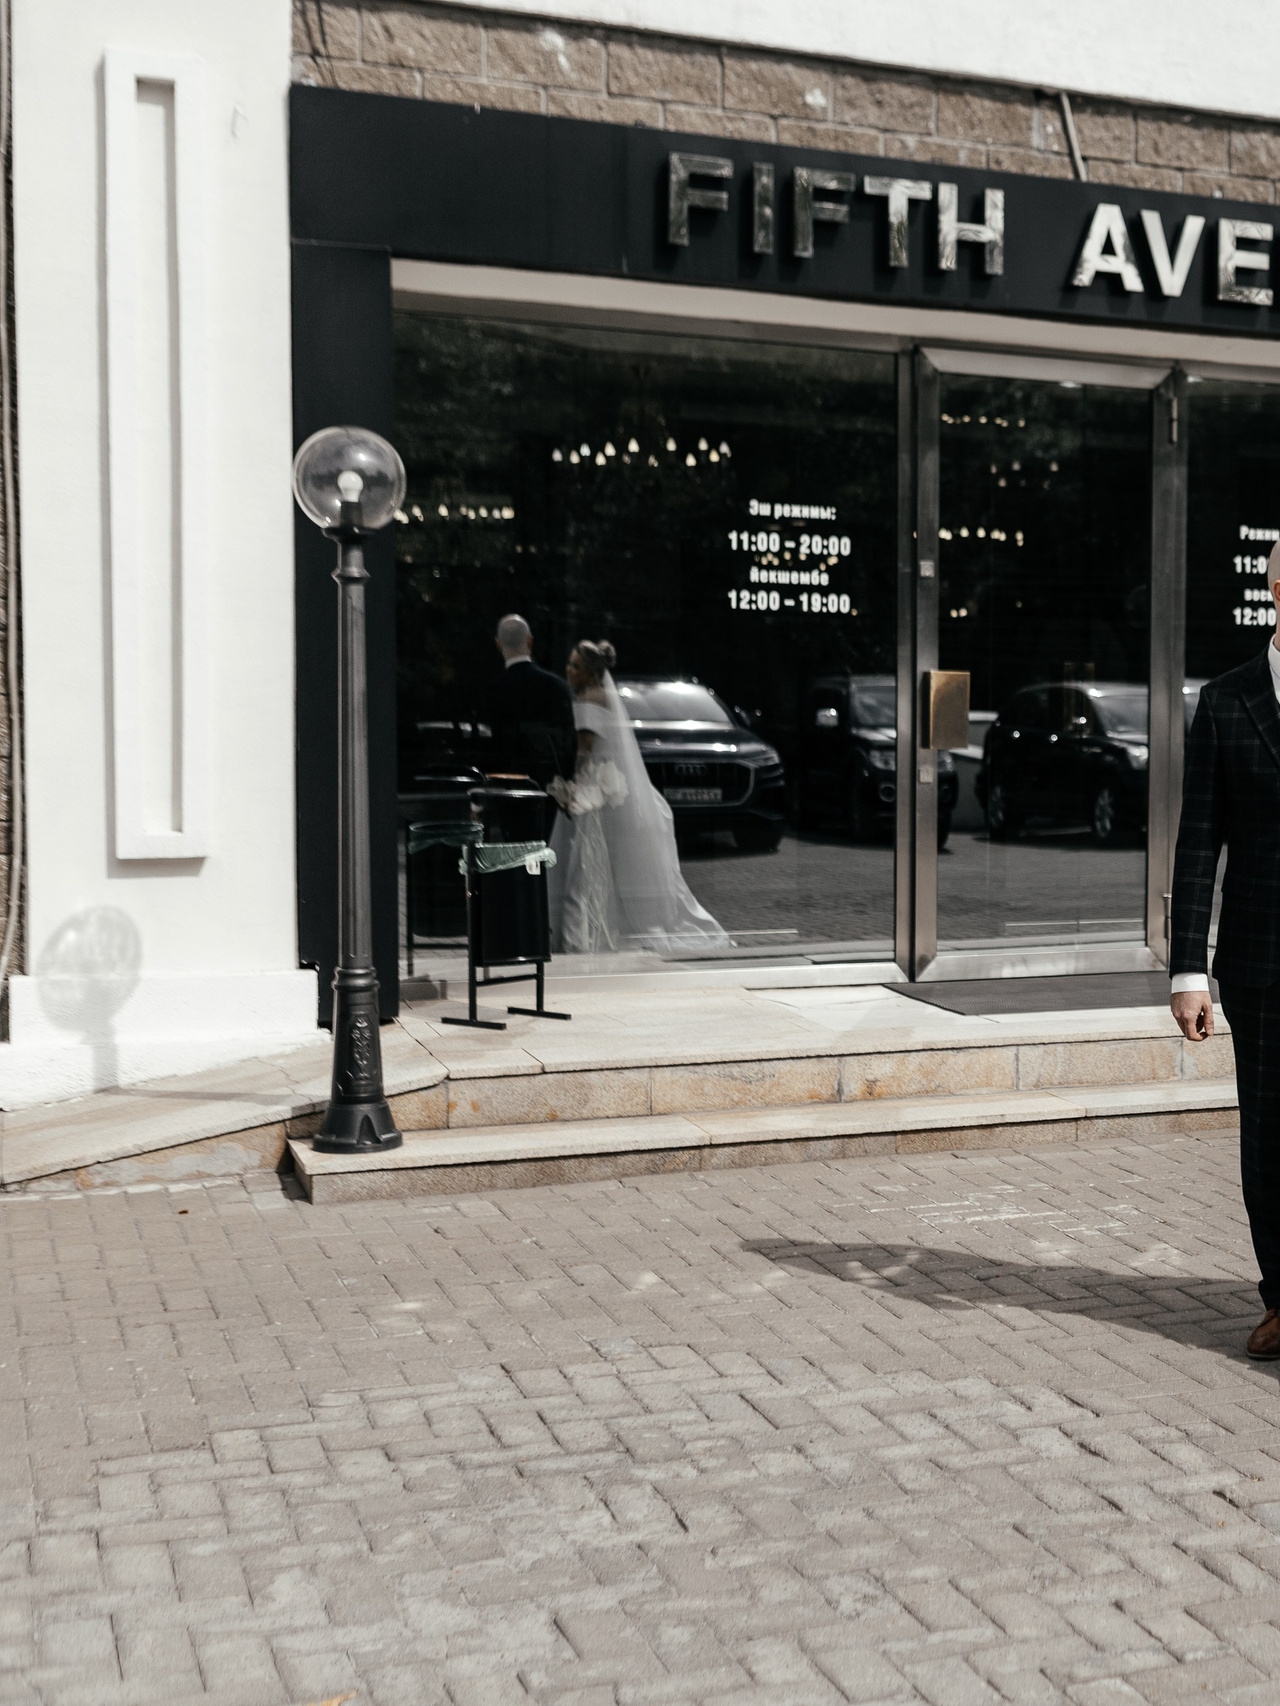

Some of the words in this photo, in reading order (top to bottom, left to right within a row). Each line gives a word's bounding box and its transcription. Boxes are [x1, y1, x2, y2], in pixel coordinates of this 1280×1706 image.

[668, 151, 1005, 276] FIFTH
[749, 498, 772, 517] Эш
[774, 502, 837, 521] режимы:
[728, 530, 780, 553] 11:00
[799, 533, 851, 557] 20:00
[1232, 554, 1270, 575] 11:0
[728, 589, 780, 611] 12:00
[799, 592, 851, 614] 19:00
[1232, 606, 1277, 627] 12:00
